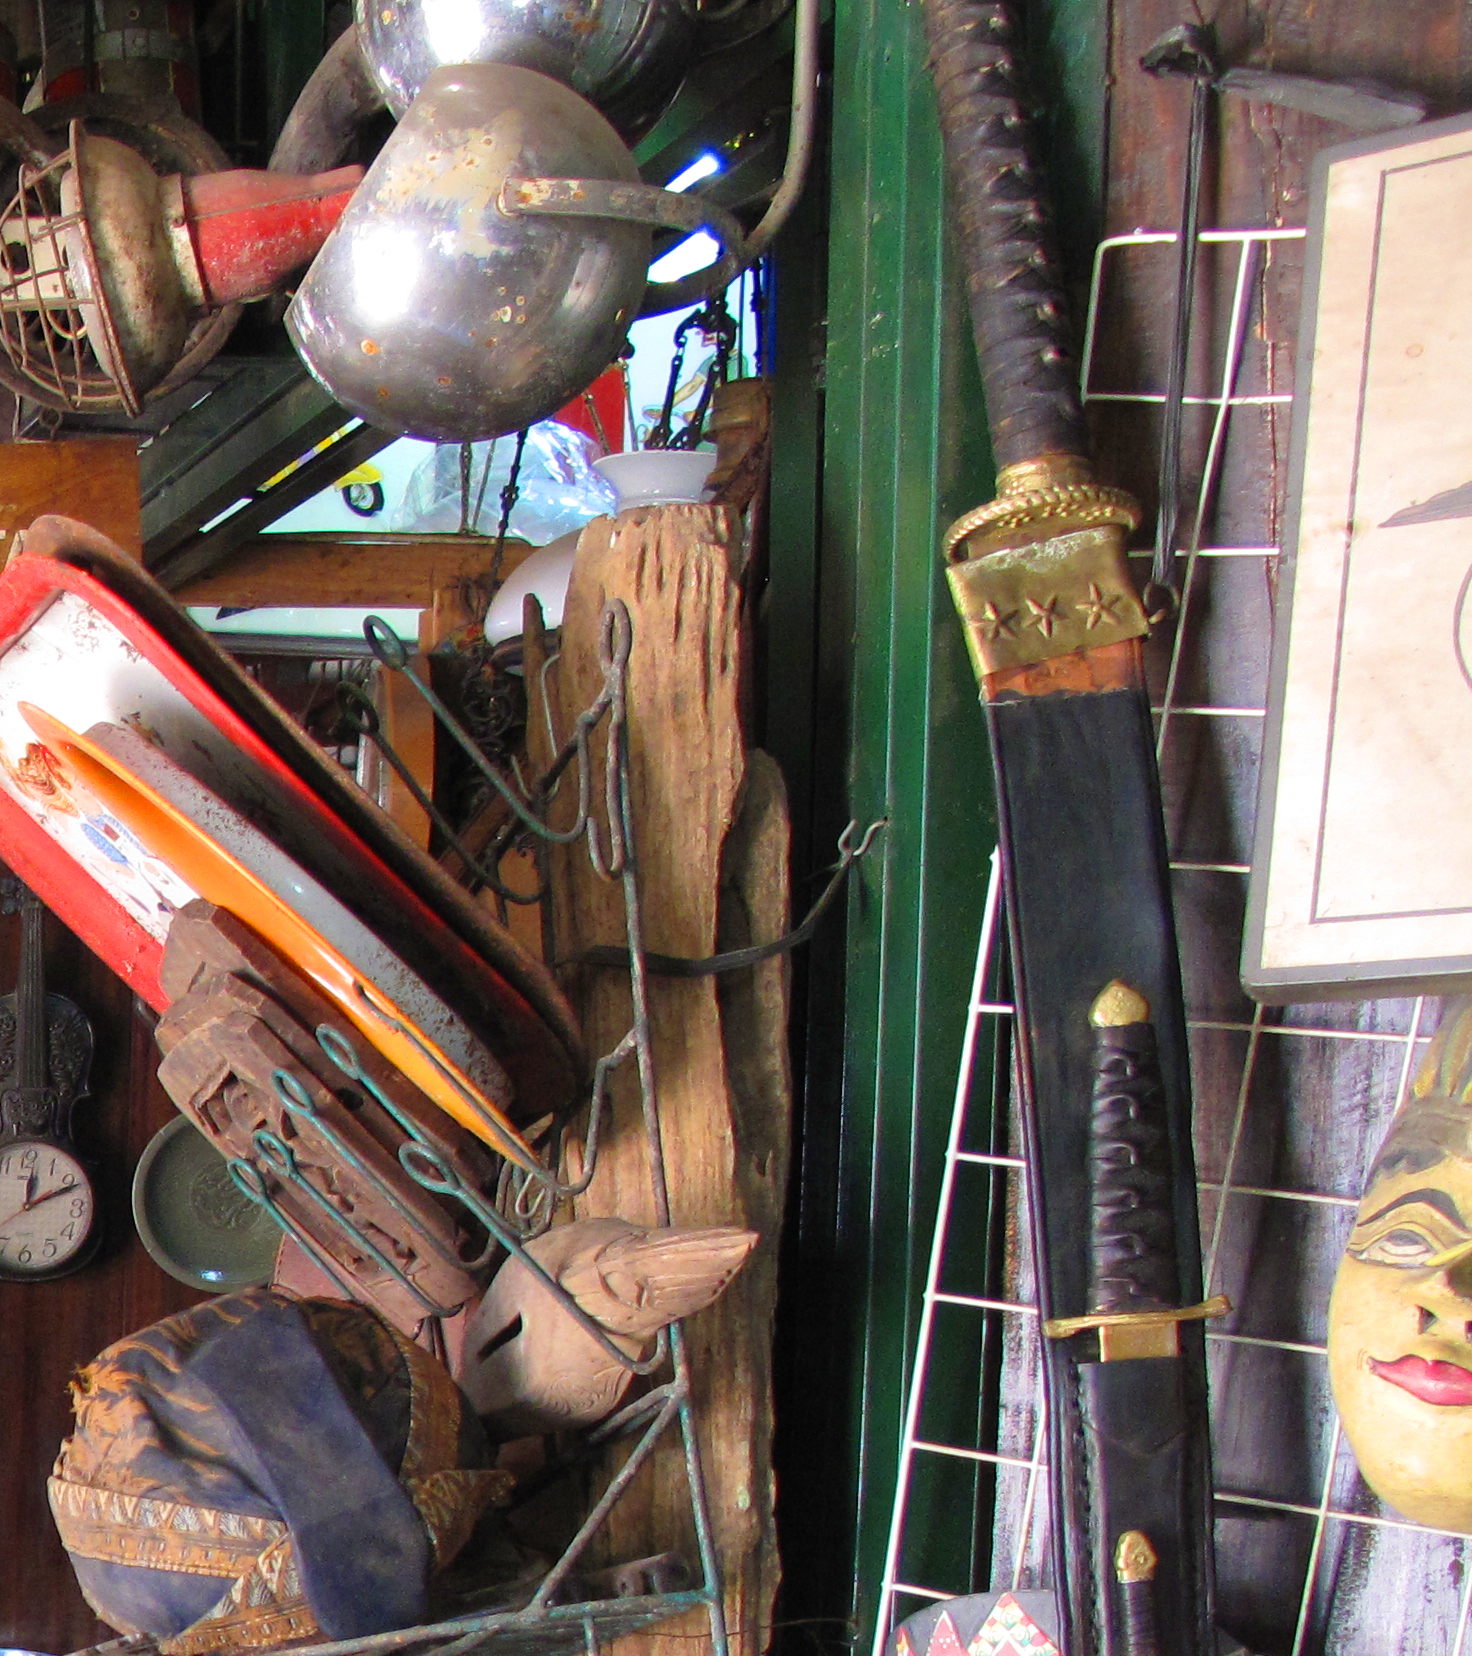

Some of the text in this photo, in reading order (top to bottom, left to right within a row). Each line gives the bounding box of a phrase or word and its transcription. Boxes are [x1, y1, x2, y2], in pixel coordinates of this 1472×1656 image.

[69, 1198, 84, 1219] 3
[60, 1221, 75, 1241] 4
[0, 1236, 11, 1256] 7
[18, 1243, 32, 1264] 6
[42, 1238, 57, 1258] 5
